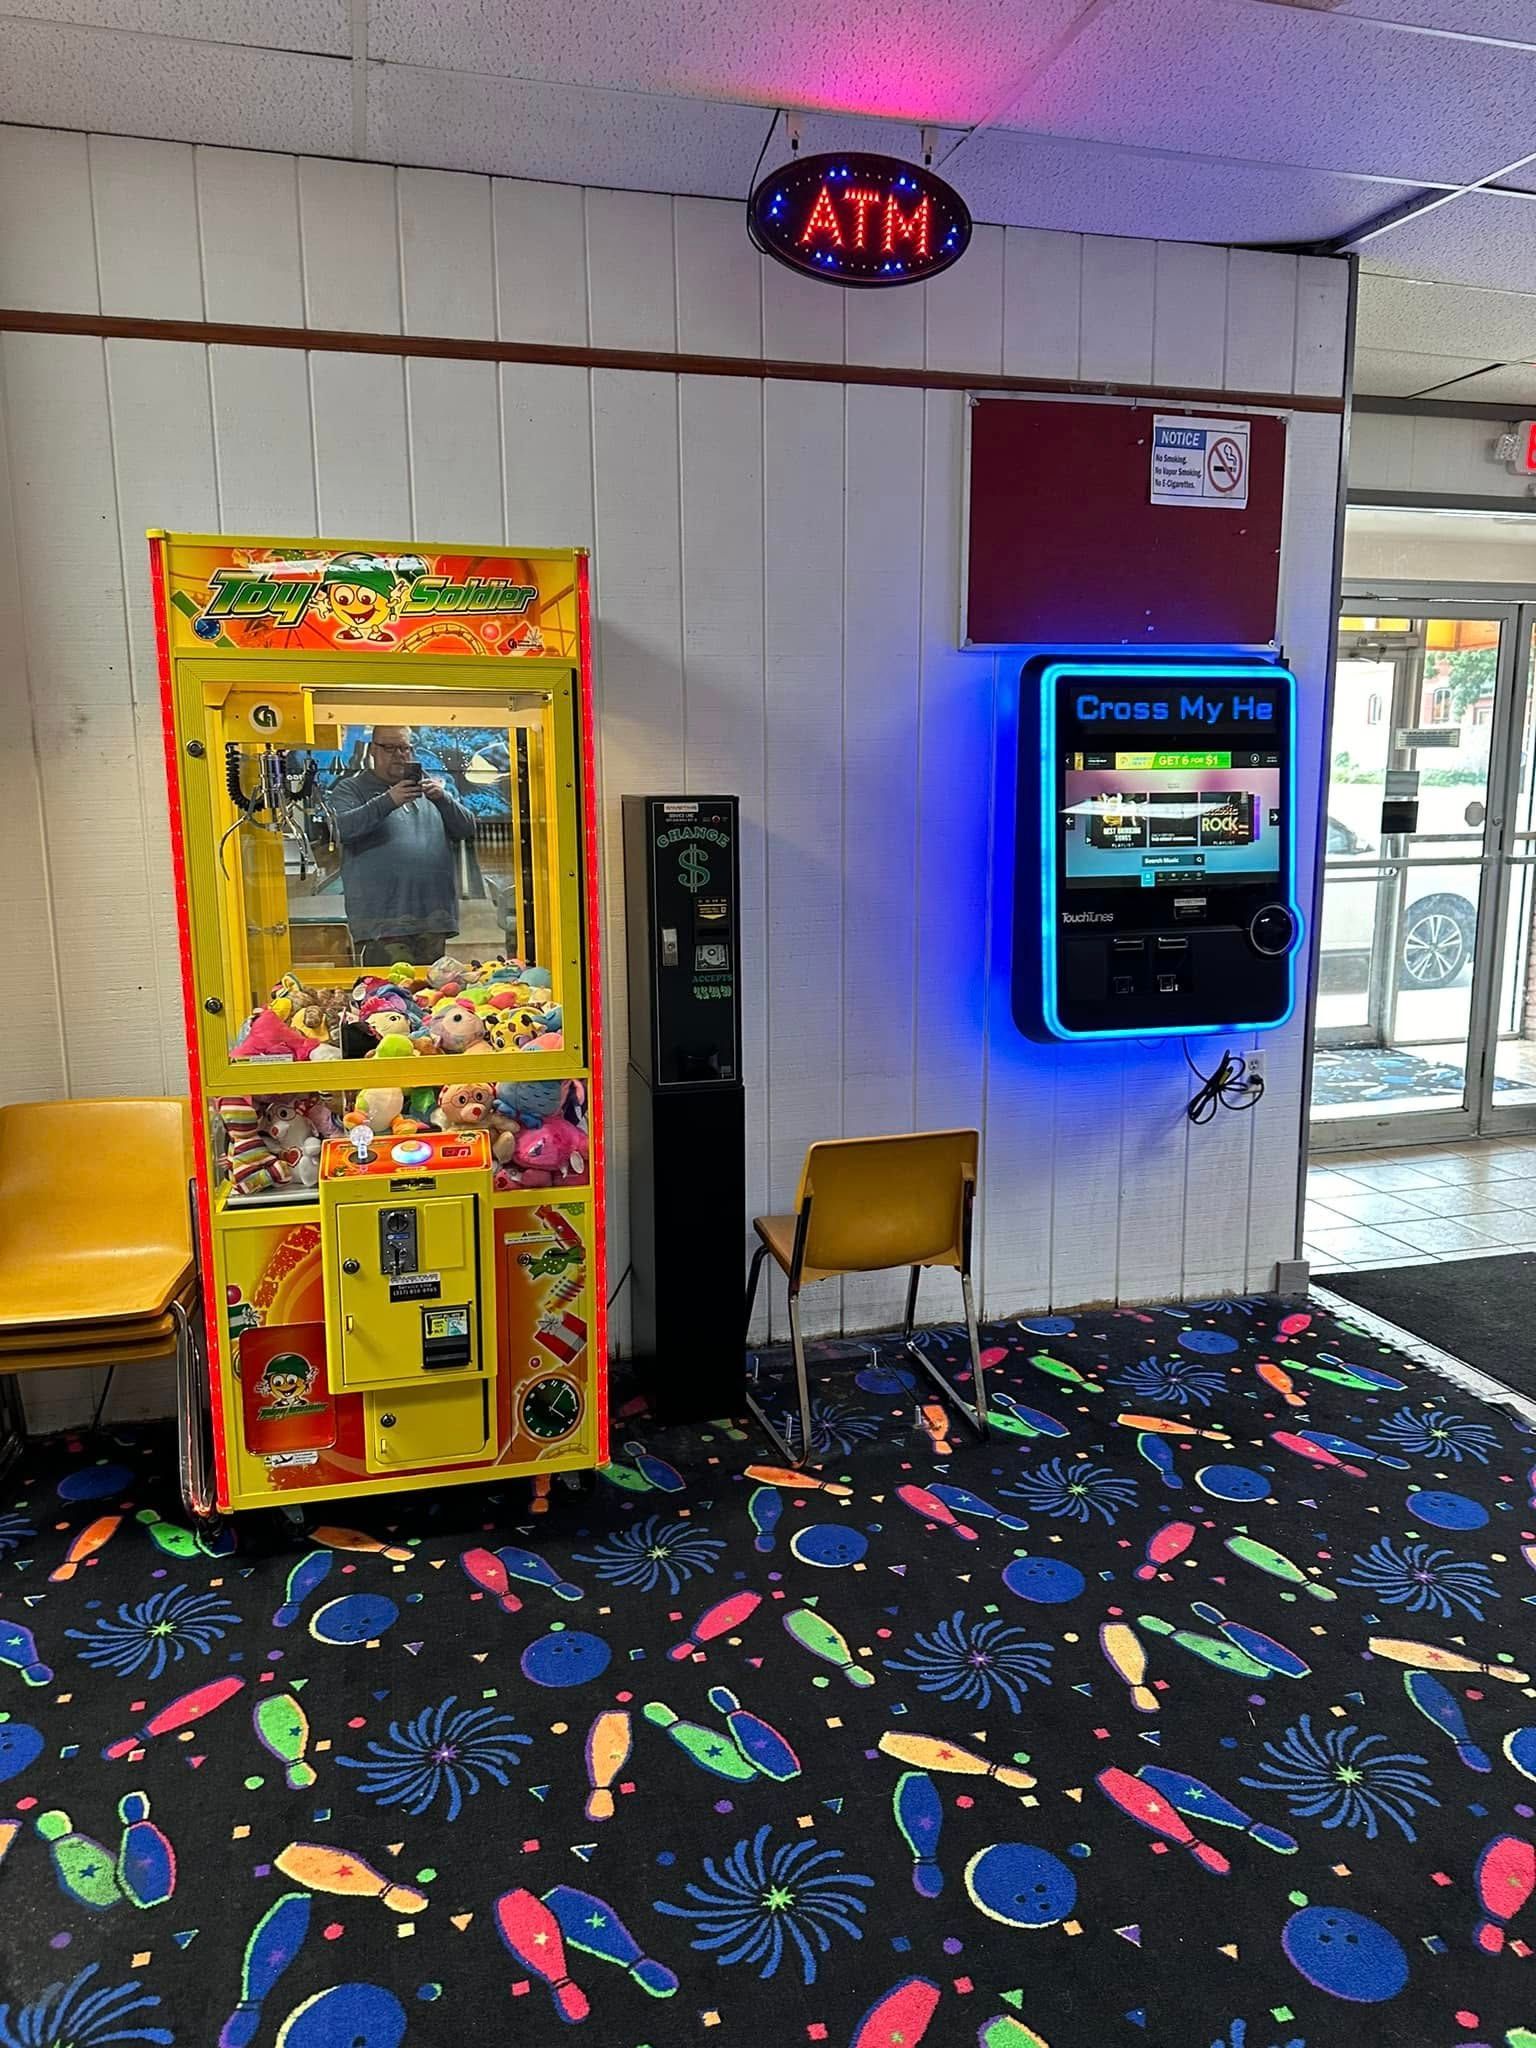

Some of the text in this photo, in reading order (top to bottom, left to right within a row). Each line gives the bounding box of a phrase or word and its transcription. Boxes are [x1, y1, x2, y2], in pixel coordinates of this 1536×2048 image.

[802, 185, 929, 254] ATM
[1161, 431, 1200, 446] NOTICE
[205, 569, 537, 626] Toy Soldier
[1076, 695, 1169, 720] Cross
[1180, 695, 1223, 723] My
[1159, 757, 1180, 766] GET
[1182, 756, 1189, 765] 6
[1206, 755, 1218, 766] $1
[1201, 817, 1239, 832] ROCK
[656, 826, 730, 848] CHANGE
[1061, 911, 1114, 923] TouchTunes
[692, 974, 733, 983] ACCEPTS
